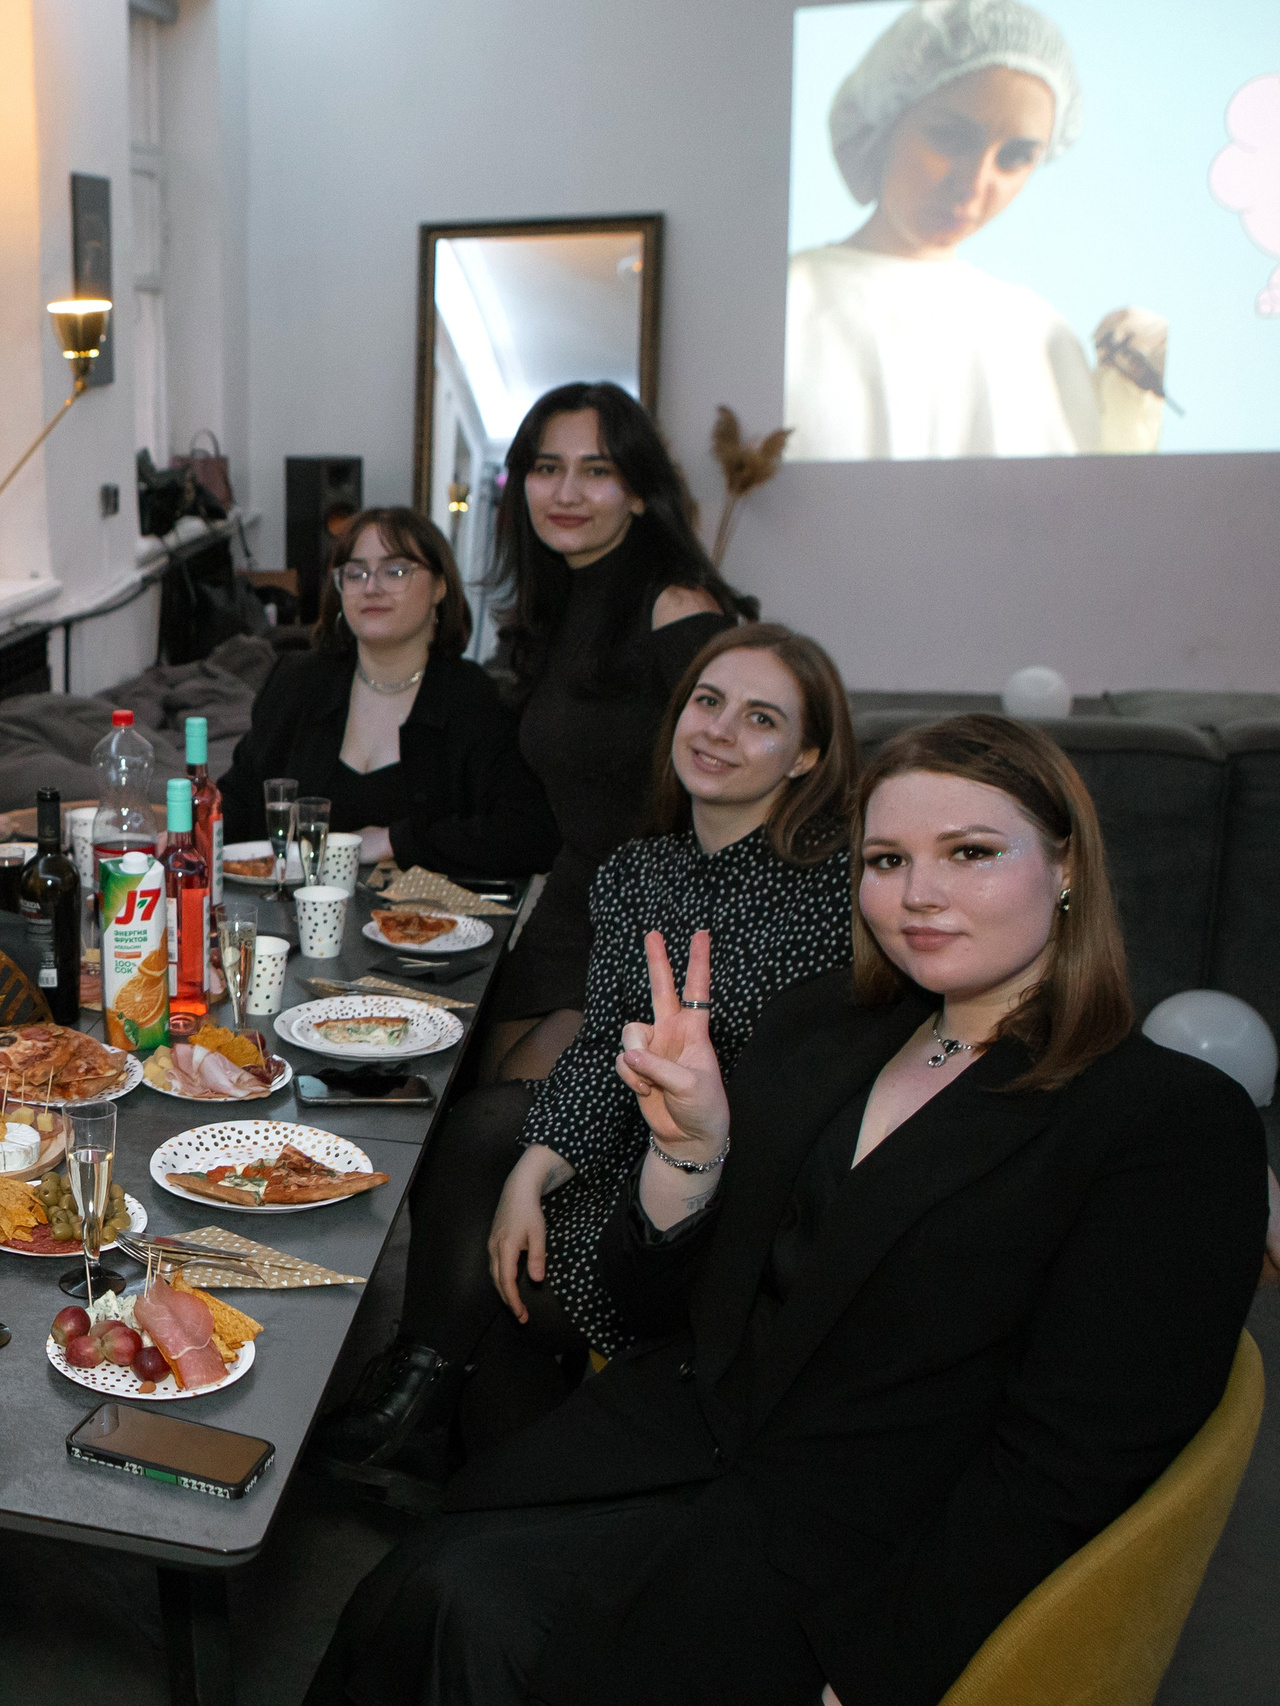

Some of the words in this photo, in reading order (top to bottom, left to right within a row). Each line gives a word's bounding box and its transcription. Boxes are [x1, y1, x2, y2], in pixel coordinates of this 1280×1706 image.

[114, 887, 161, 925] J7
[114, 929, 147, 937] ЭНЕРГИЯ
[114, 936, 148, 944] ФРУКТОВ
[114, 966, 133, 974] СОК
